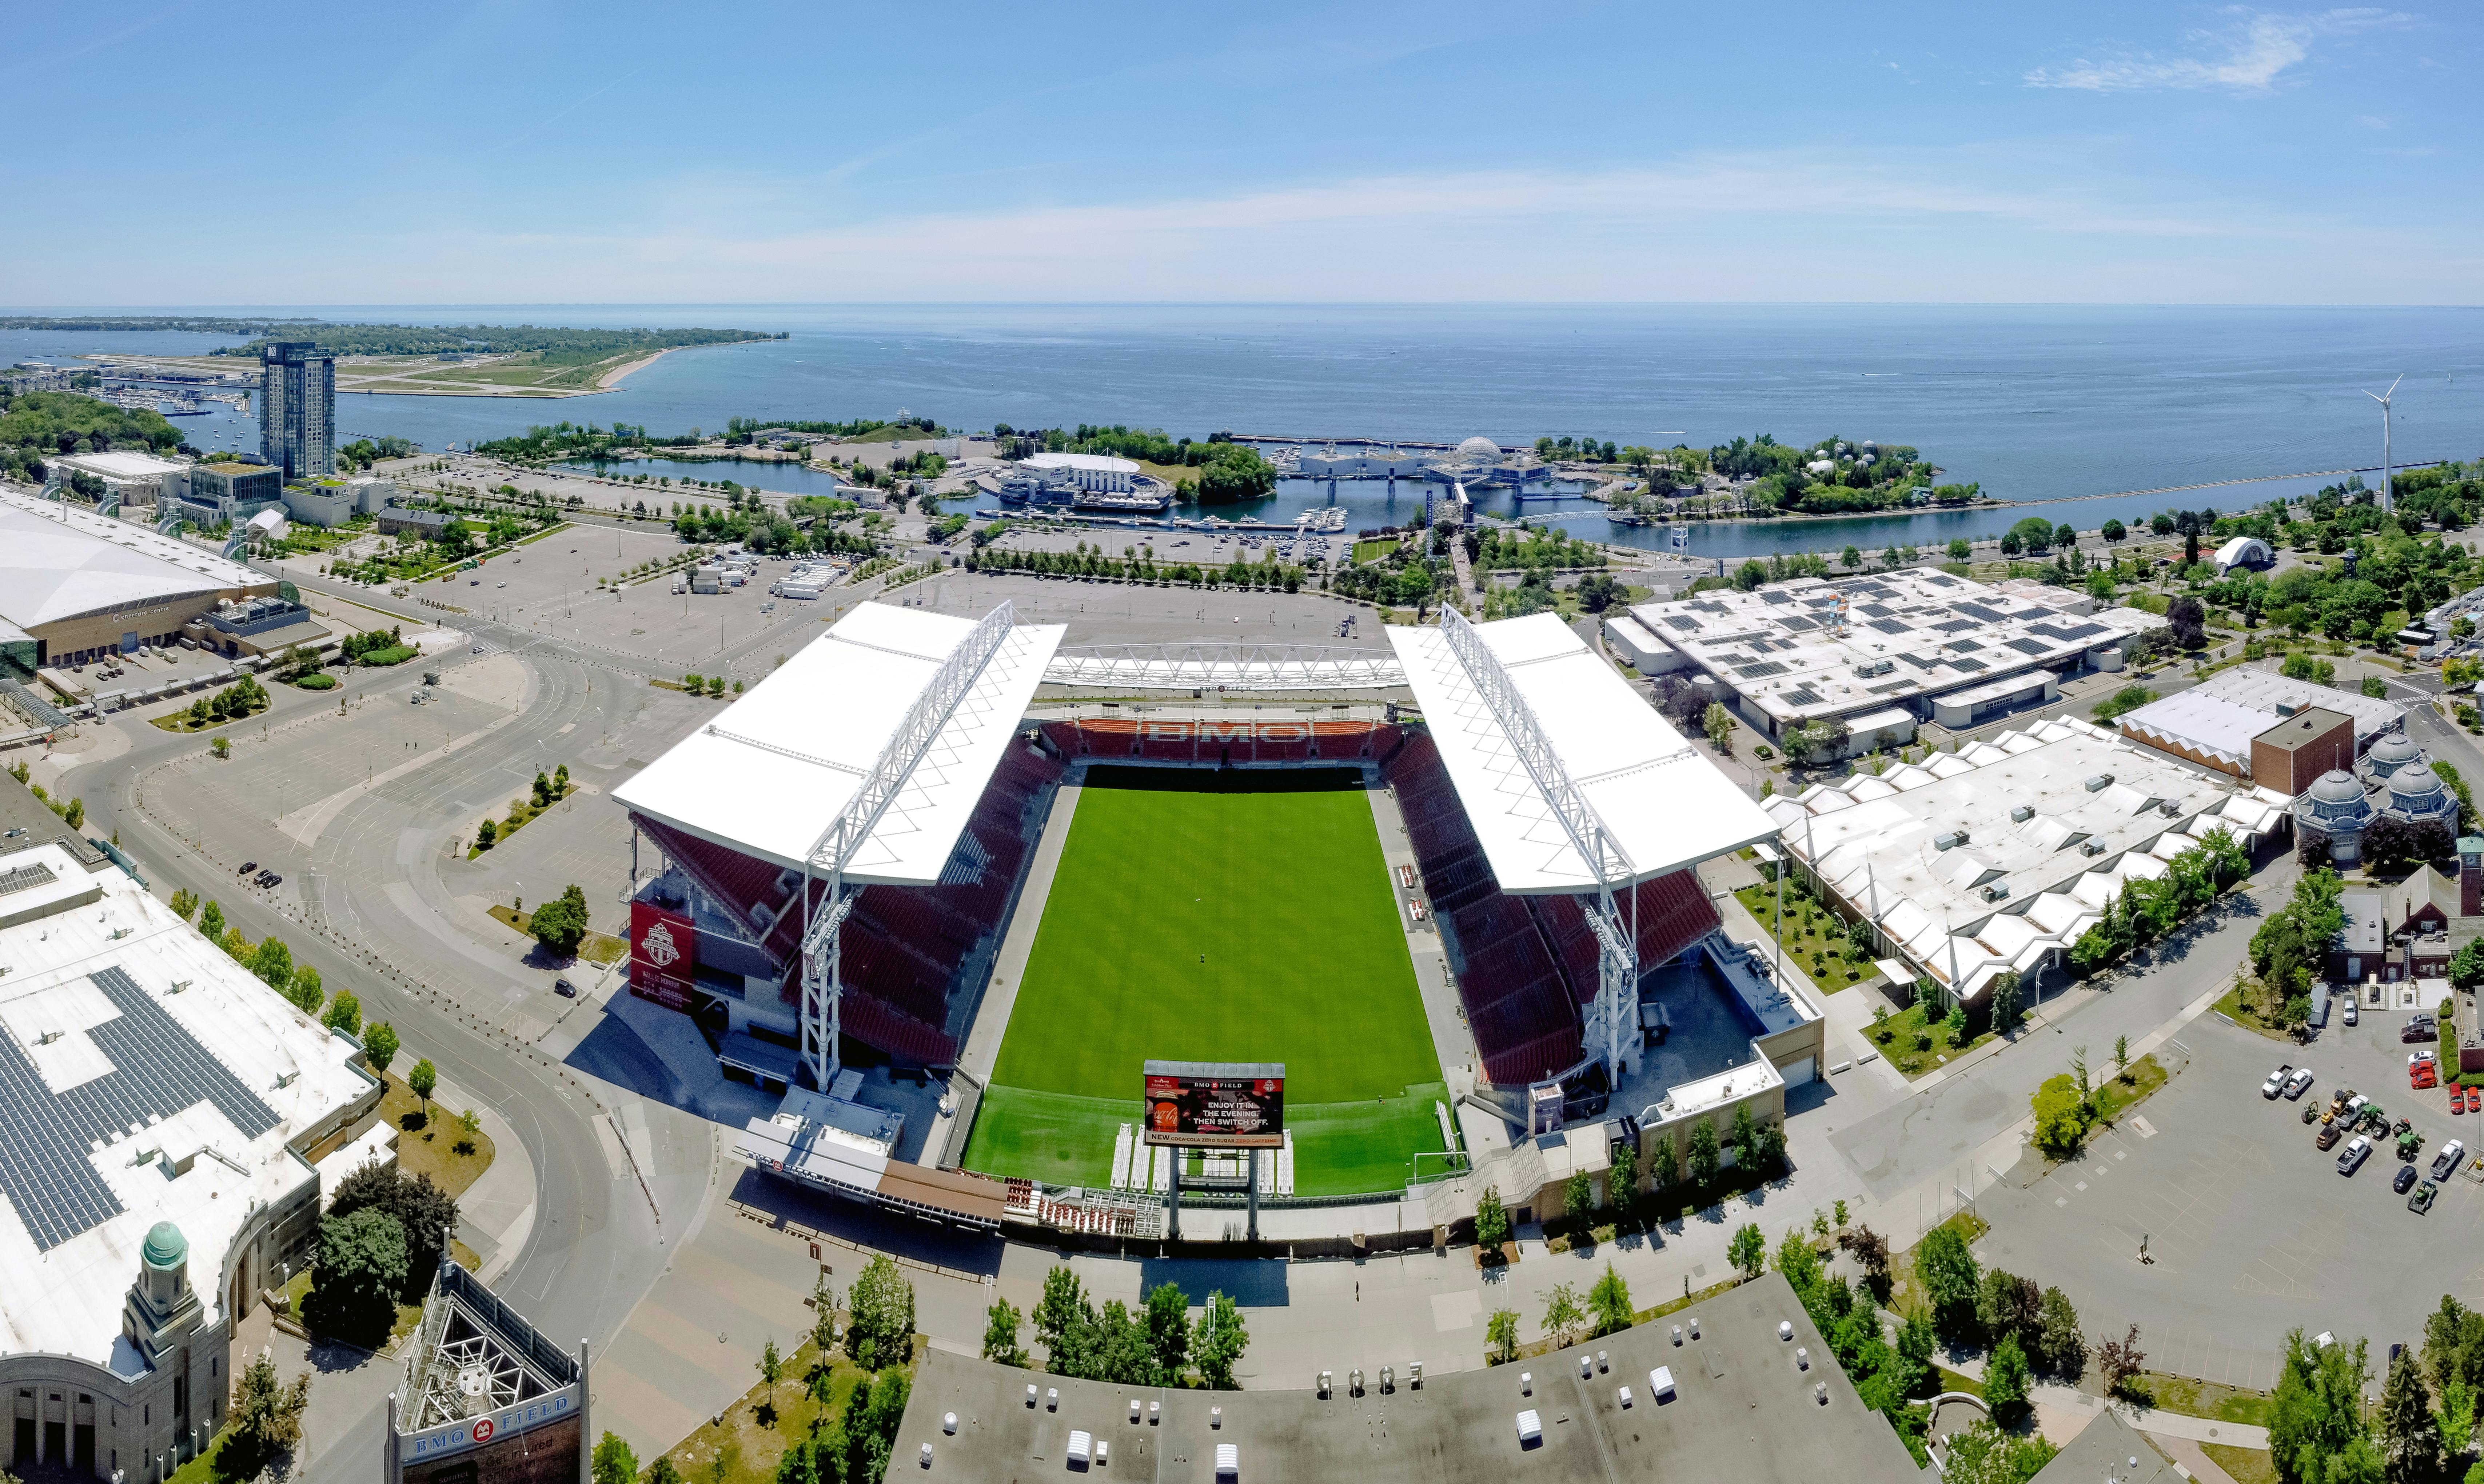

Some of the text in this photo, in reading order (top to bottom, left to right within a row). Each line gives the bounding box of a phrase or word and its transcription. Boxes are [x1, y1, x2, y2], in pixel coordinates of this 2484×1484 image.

[121, 611, 147, 619] enercare
[1147, 724, 1307, 742] BMO
[647, 940, 674, 952] TORONTO
[642, 971, 654, 980] WALL
[661, 977, 679, 989] HONOUR
[812, 1247, 817, 1258] 1
[415, 1396, 568, 1453] BMO FIELD
[486, 1452, 506, 1467] Get
[439, 1470, 469, 1483] sonnet
[486, 1464, 522, 1482] online
